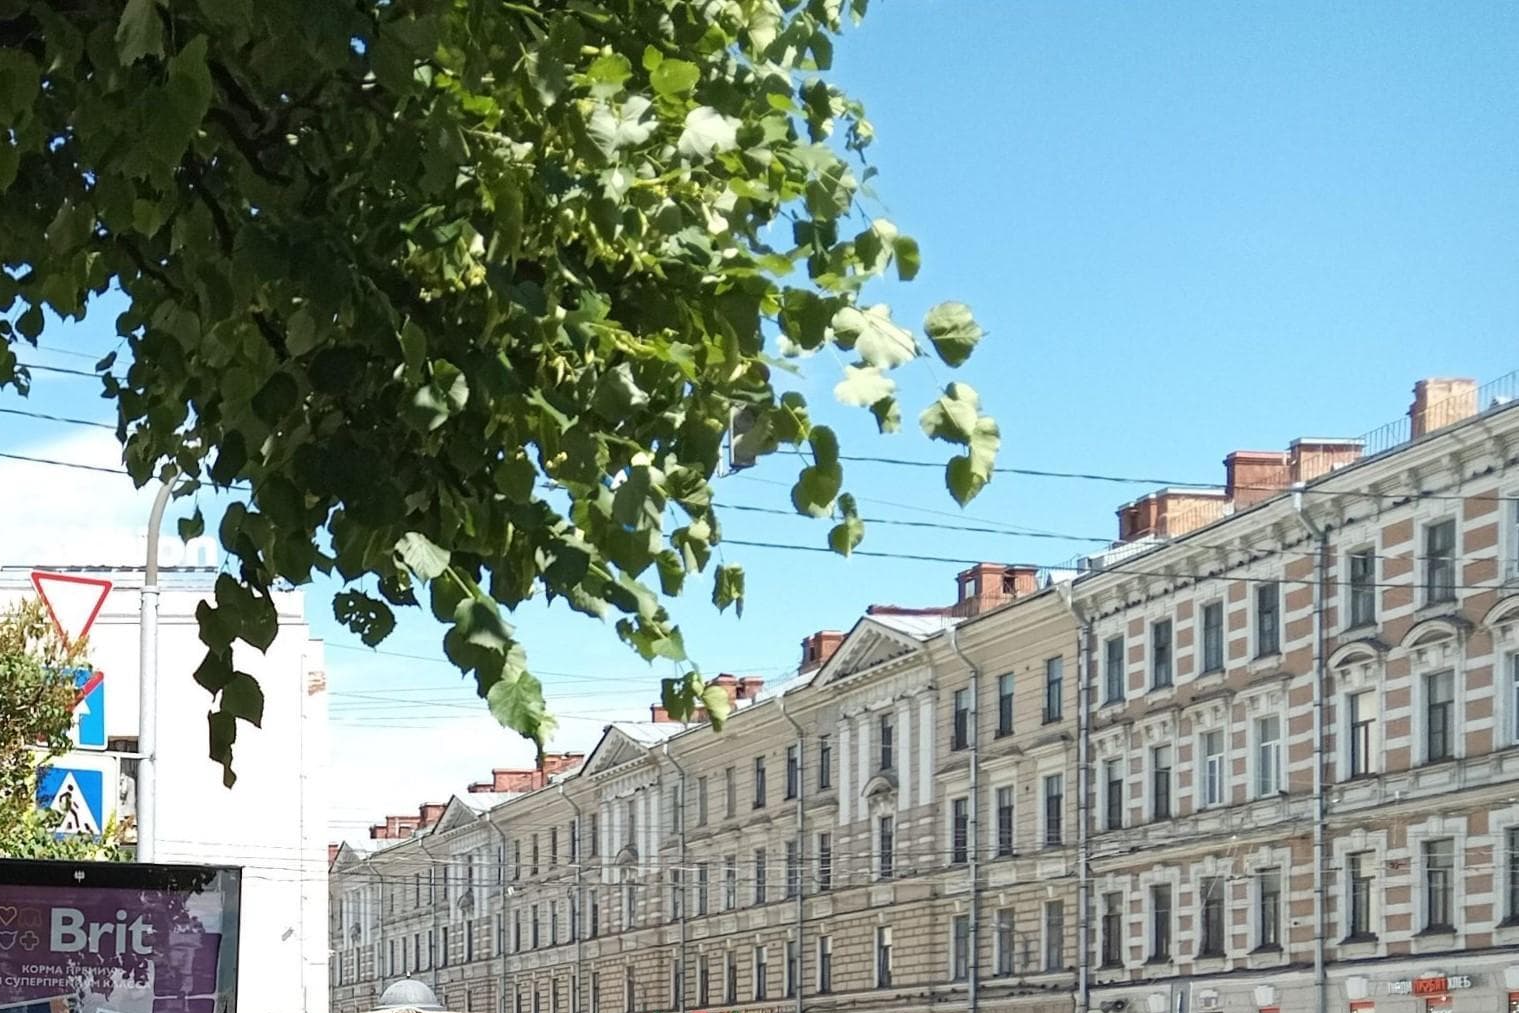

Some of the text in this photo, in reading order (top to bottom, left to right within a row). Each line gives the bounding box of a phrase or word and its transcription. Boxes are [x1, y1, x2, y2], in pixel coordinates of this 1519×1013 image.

[50, 907, 153, 955] Brit
[22, 964, 124, 977] КОРМА ПРЕМИУ
